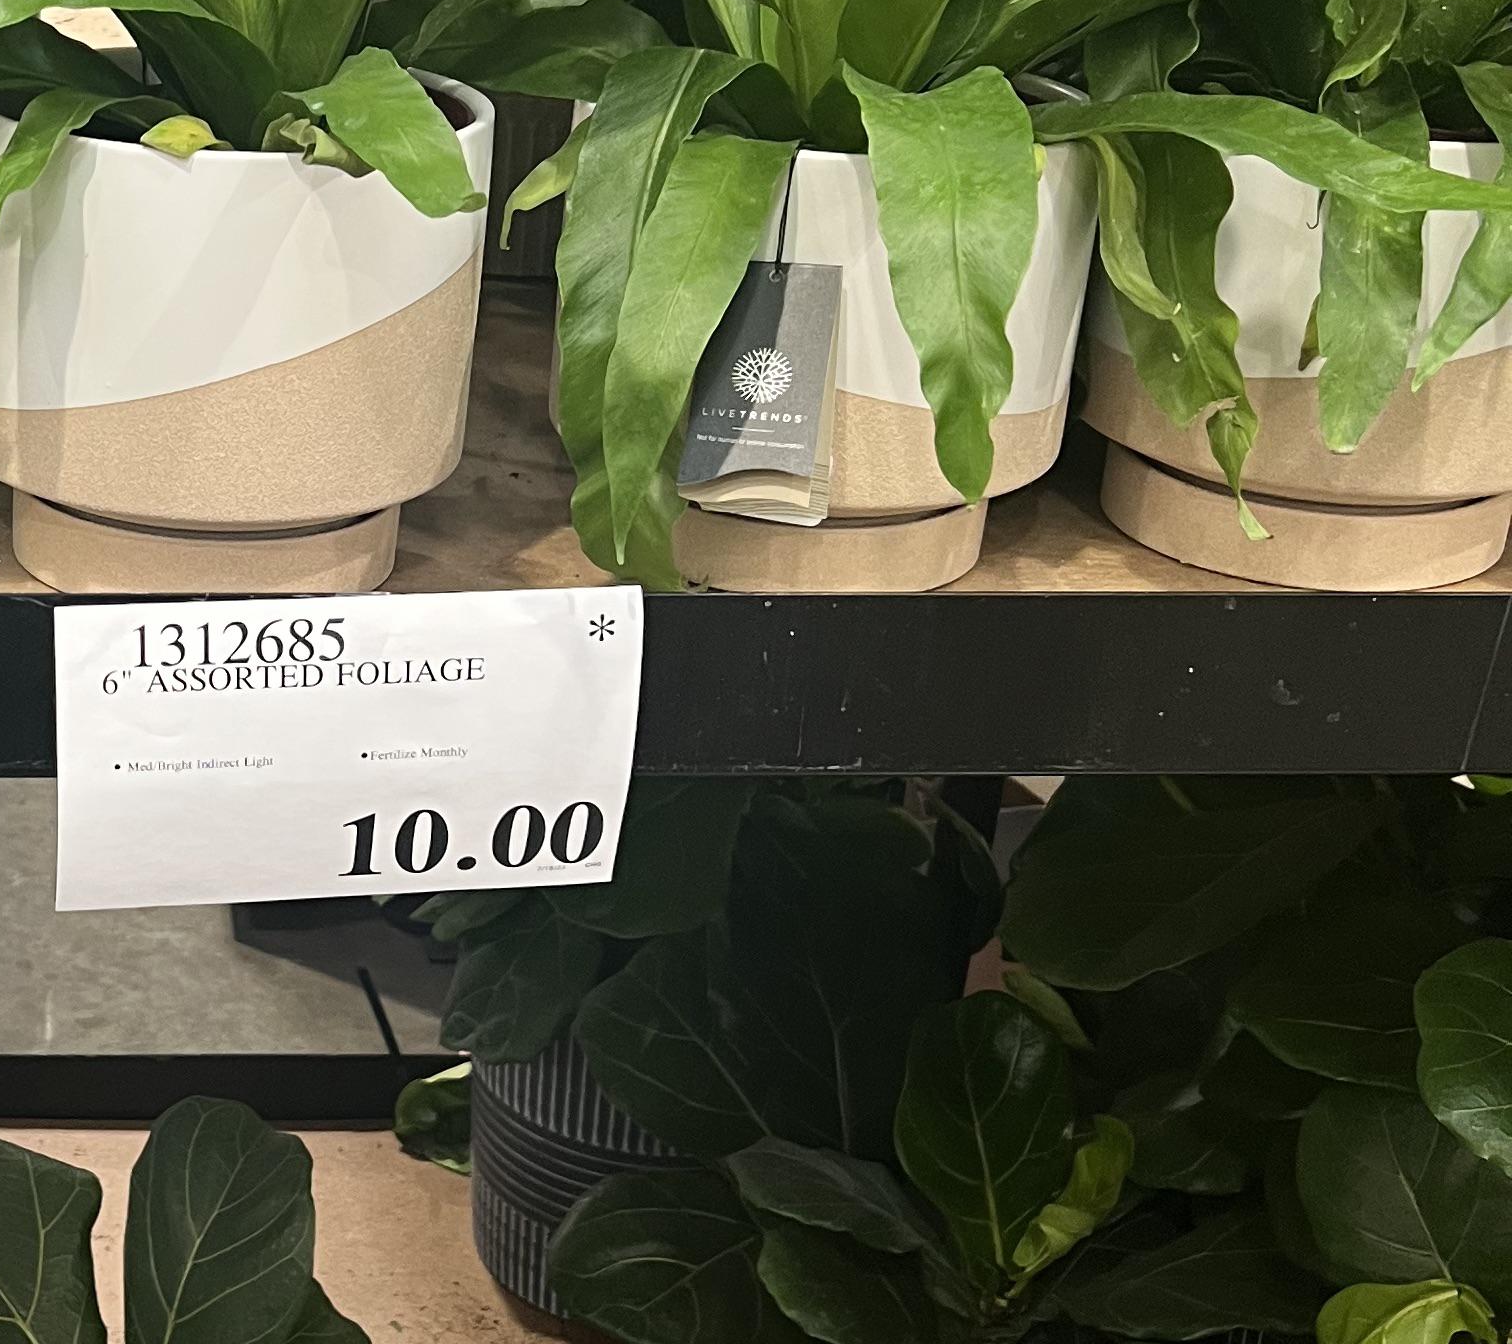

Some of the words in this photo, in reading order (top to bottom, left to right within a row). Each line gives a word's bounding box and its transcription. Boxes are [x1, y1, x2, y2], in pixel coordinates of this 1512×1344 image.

[701, 407, 803, 424] LIVETRENDS
[133, 617, 346, 669] 1312685
[102, 669, 132, 695] 6"
[147, 664, 324, 693] ASSORTED
[337, 657, 486, 687] FOLIAGE
[128, 759, 192, 774] Med/Bright
[197, 758, 240, 770] Indirect
[244, 756, 275, 770] Light
[370, 748, 418, 761] Fertilize
[421, 746, 469, 760] Monthly
[338, 801, 604, 876] 10.00
